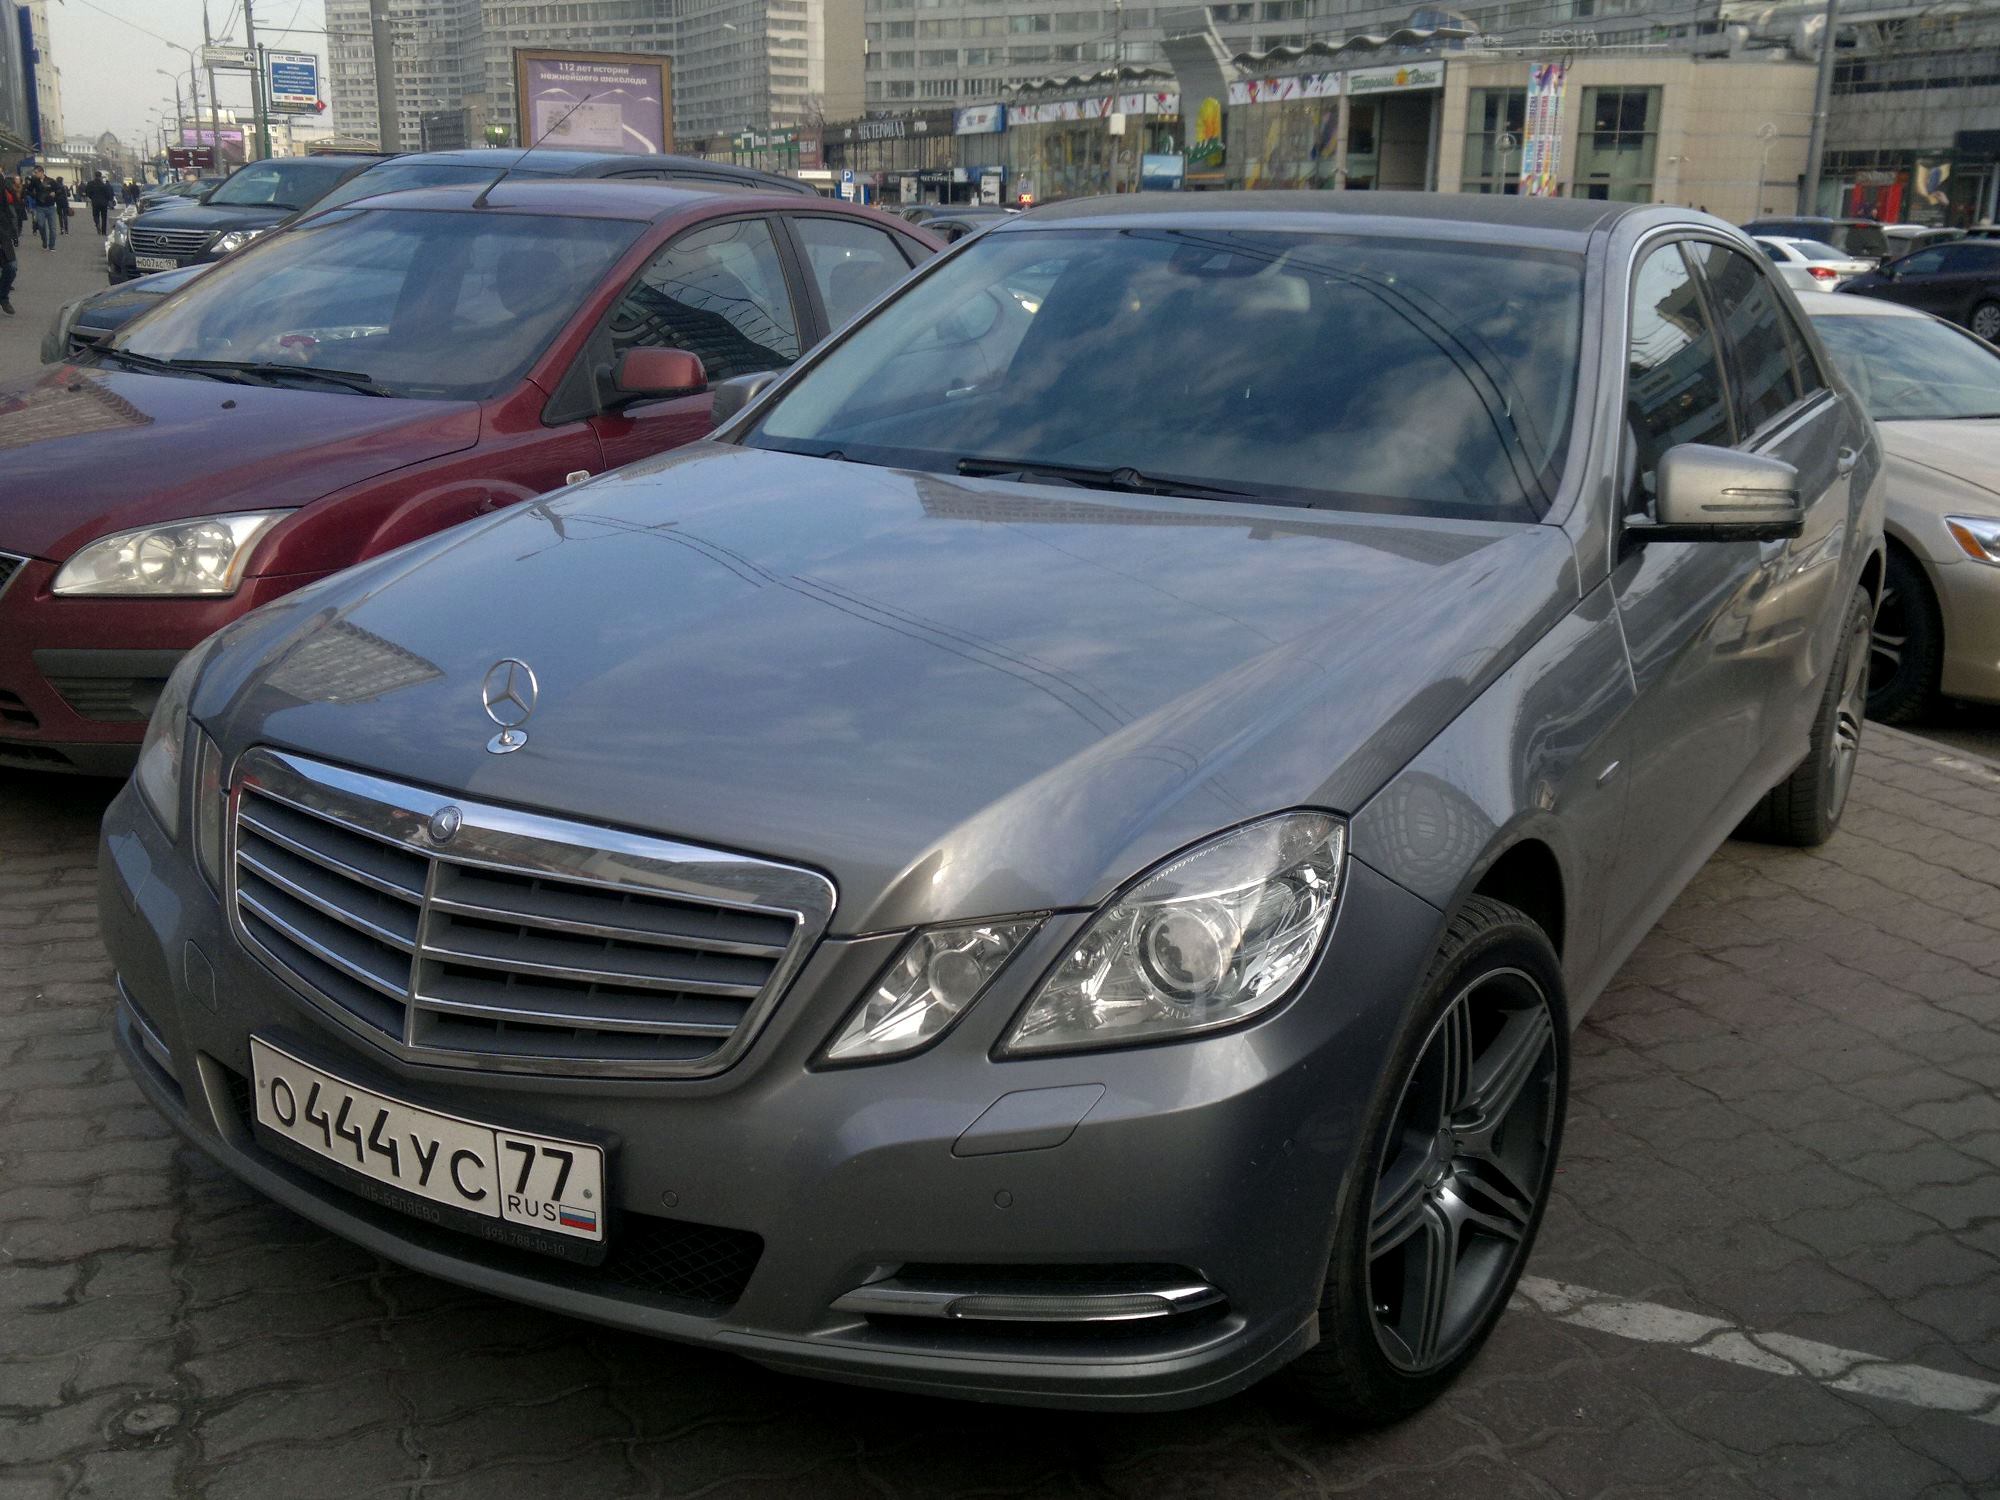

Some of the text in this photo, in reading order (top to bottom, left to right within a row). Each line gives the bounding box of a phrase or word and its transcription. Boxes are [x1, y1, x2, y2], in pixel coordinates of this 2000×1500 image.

[1539, 28, 1598, 44] ВЕСНА
[559, 62, 630, 76] 112 лет истории
[539, 72, 648, 86] нежнейшего шоколада
[844, 171, 851, 181] P
[505, 1140, 574, 1202] 77
[507, 1194, 557, 1222] RUS
